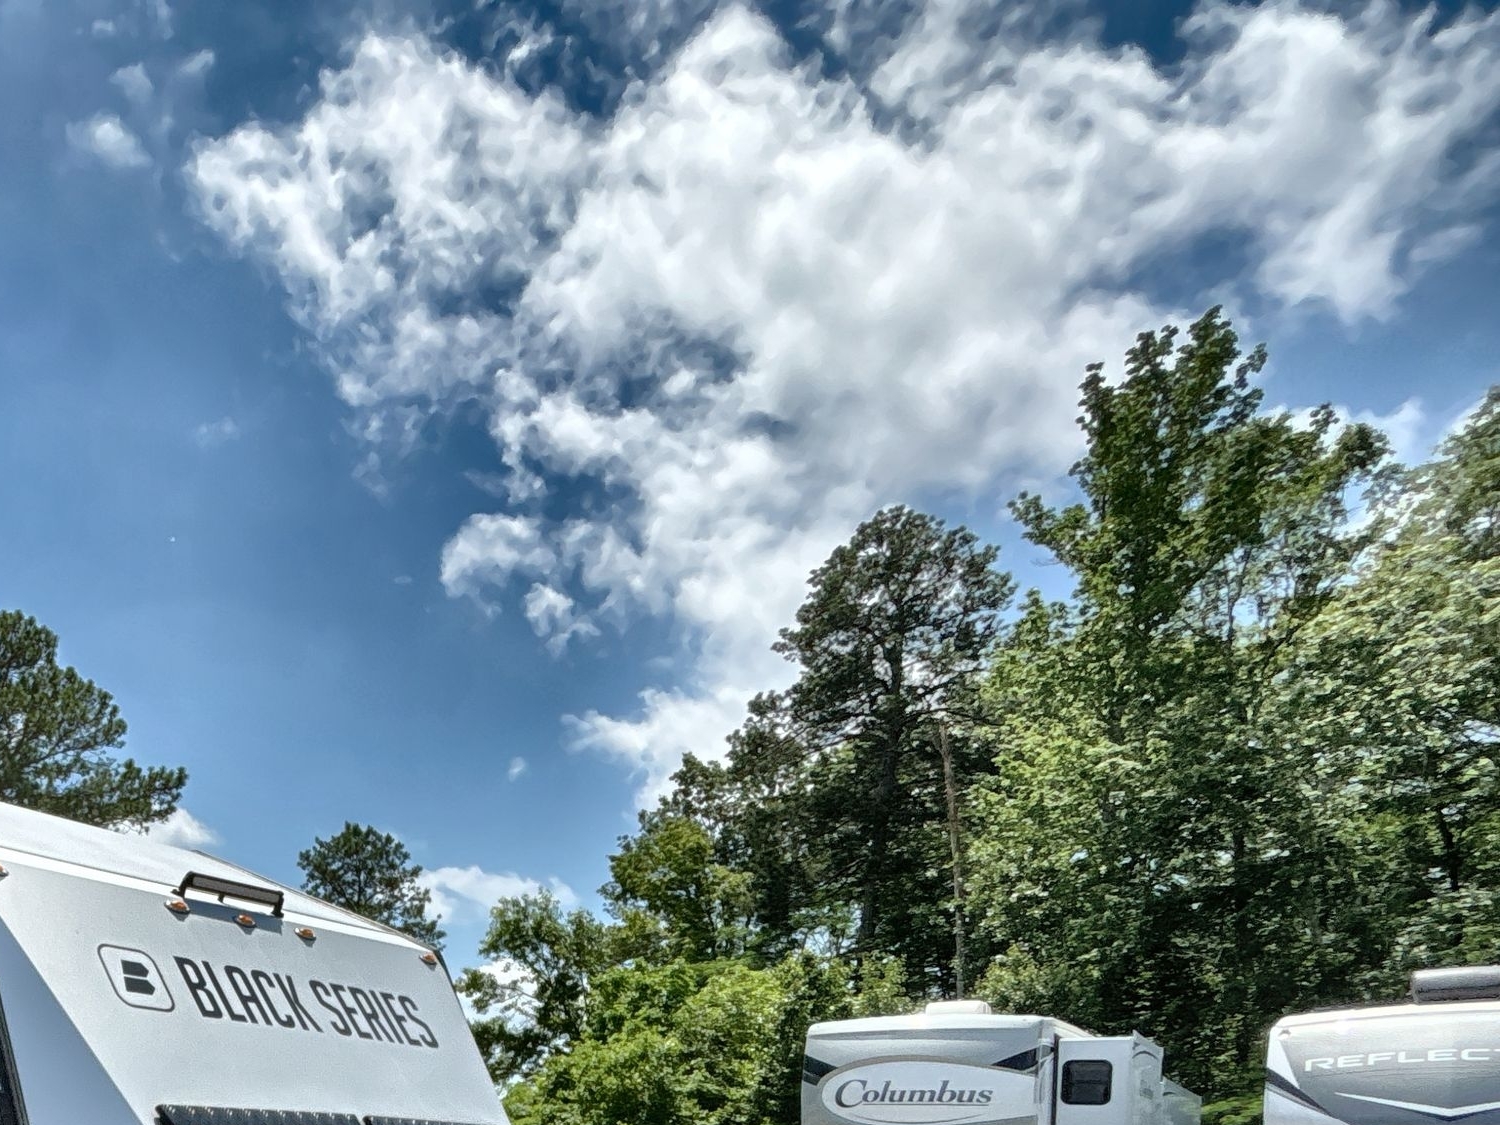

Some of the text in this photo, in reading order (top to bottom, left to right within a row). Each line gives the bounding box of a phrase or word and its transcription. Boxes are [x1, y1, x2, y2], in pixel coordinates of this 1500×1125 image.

[173, 956, 324, 1033] BLACK
[308, 979, 439, 1049] SERIES
[1304, 1048, 1500, 1072] REFLEC
[835, 1079, 993, 1108] Columbus
